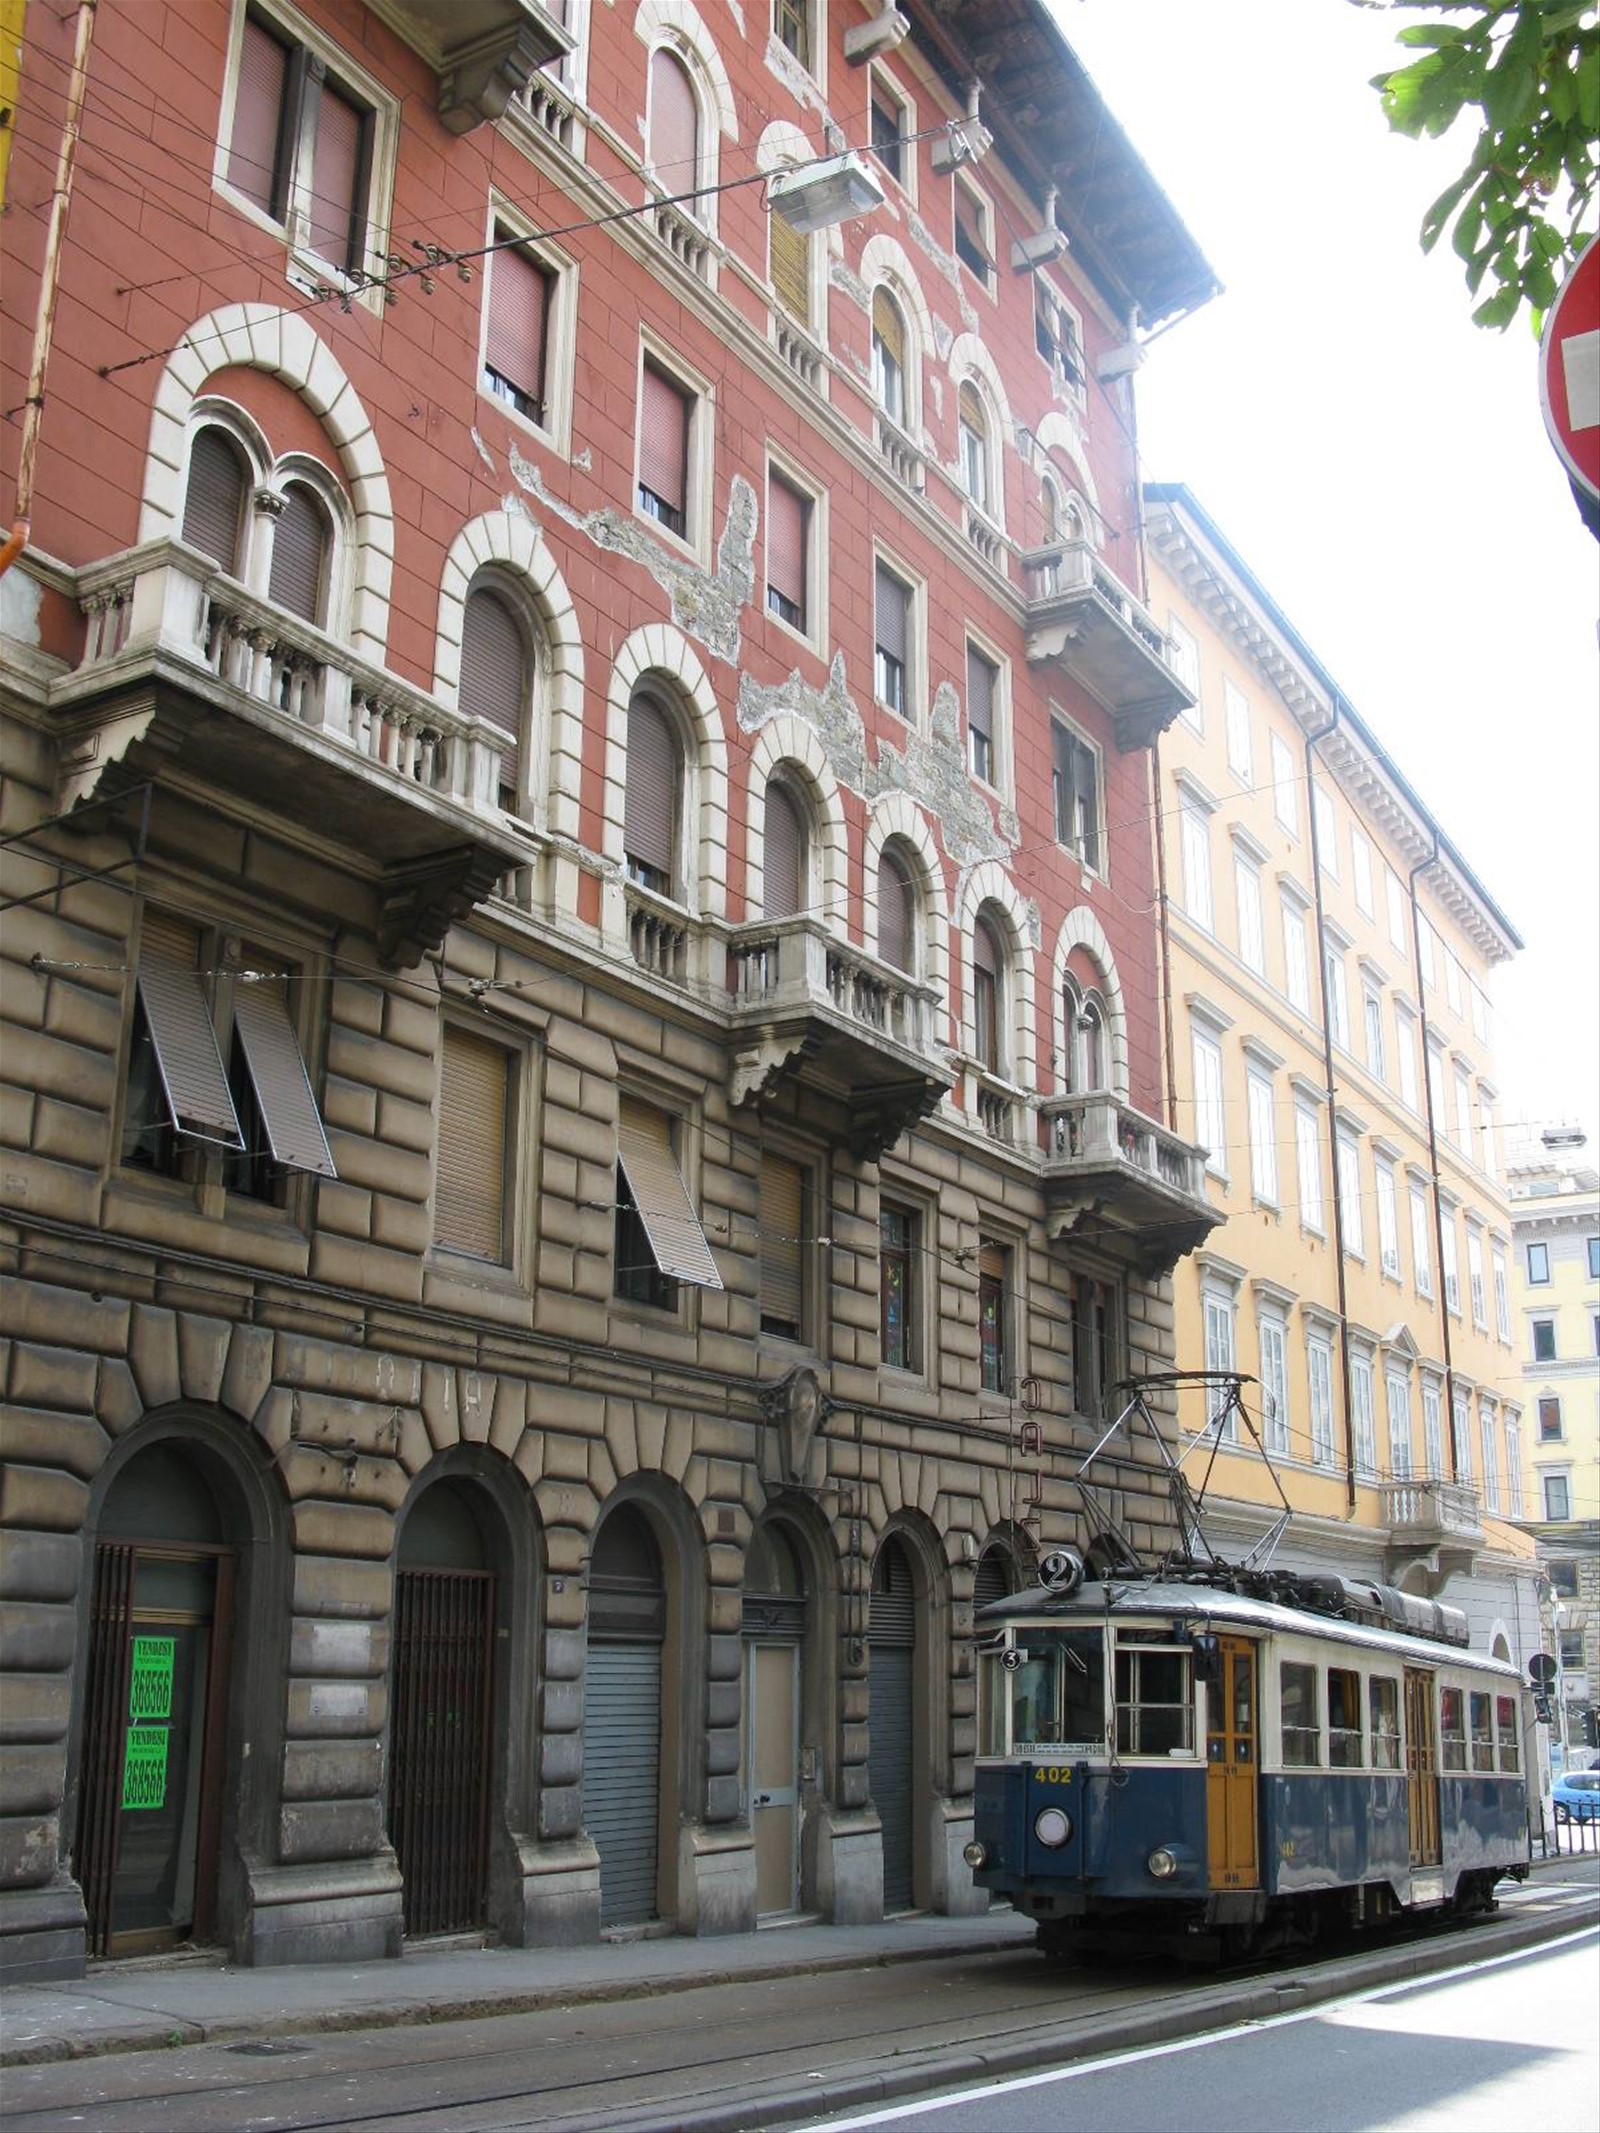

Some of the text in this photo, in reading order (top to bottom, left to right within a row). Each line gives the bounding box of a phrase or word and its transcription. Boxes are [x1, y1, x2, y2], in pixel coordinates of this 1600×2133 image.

[1046, 1555, 1067, 1588] 2
[1007, 1652, 1017, 1668] 3
[131, 1730, 166, 1746] VENDESI
[1035, 1767, 1071, 1783] 402
